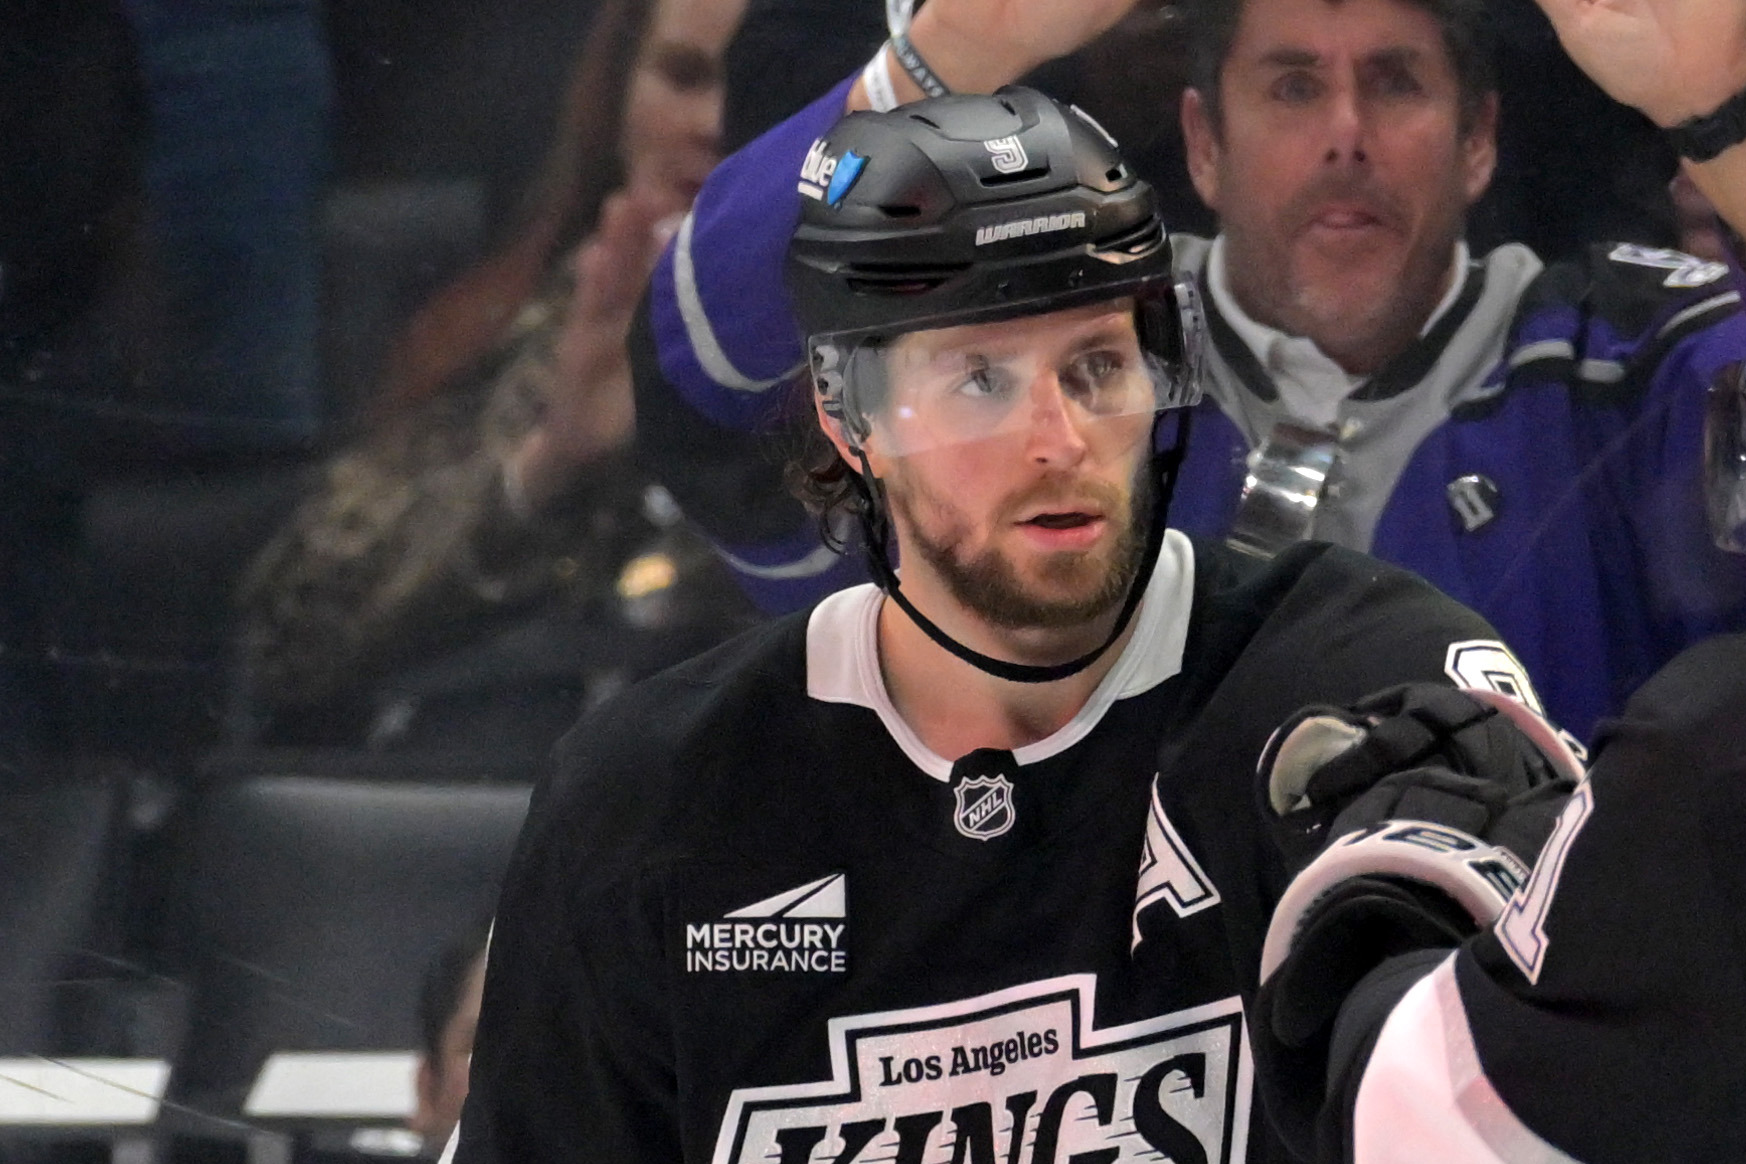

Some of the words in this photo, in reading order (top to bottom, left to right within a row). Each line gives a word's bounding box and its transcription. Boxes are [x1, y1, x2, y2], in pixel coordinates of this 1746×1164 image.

[976, 212, 1087, 246] WARRIOR
[968, 791, 1003, 829] NHL
[686, 923, 846, 949] MERCURY
[686, 950, 847, 972] INSURANCE
[879, 1053, 943, 1087] Los
[949, 1028, 1060, 1077] Angeles
